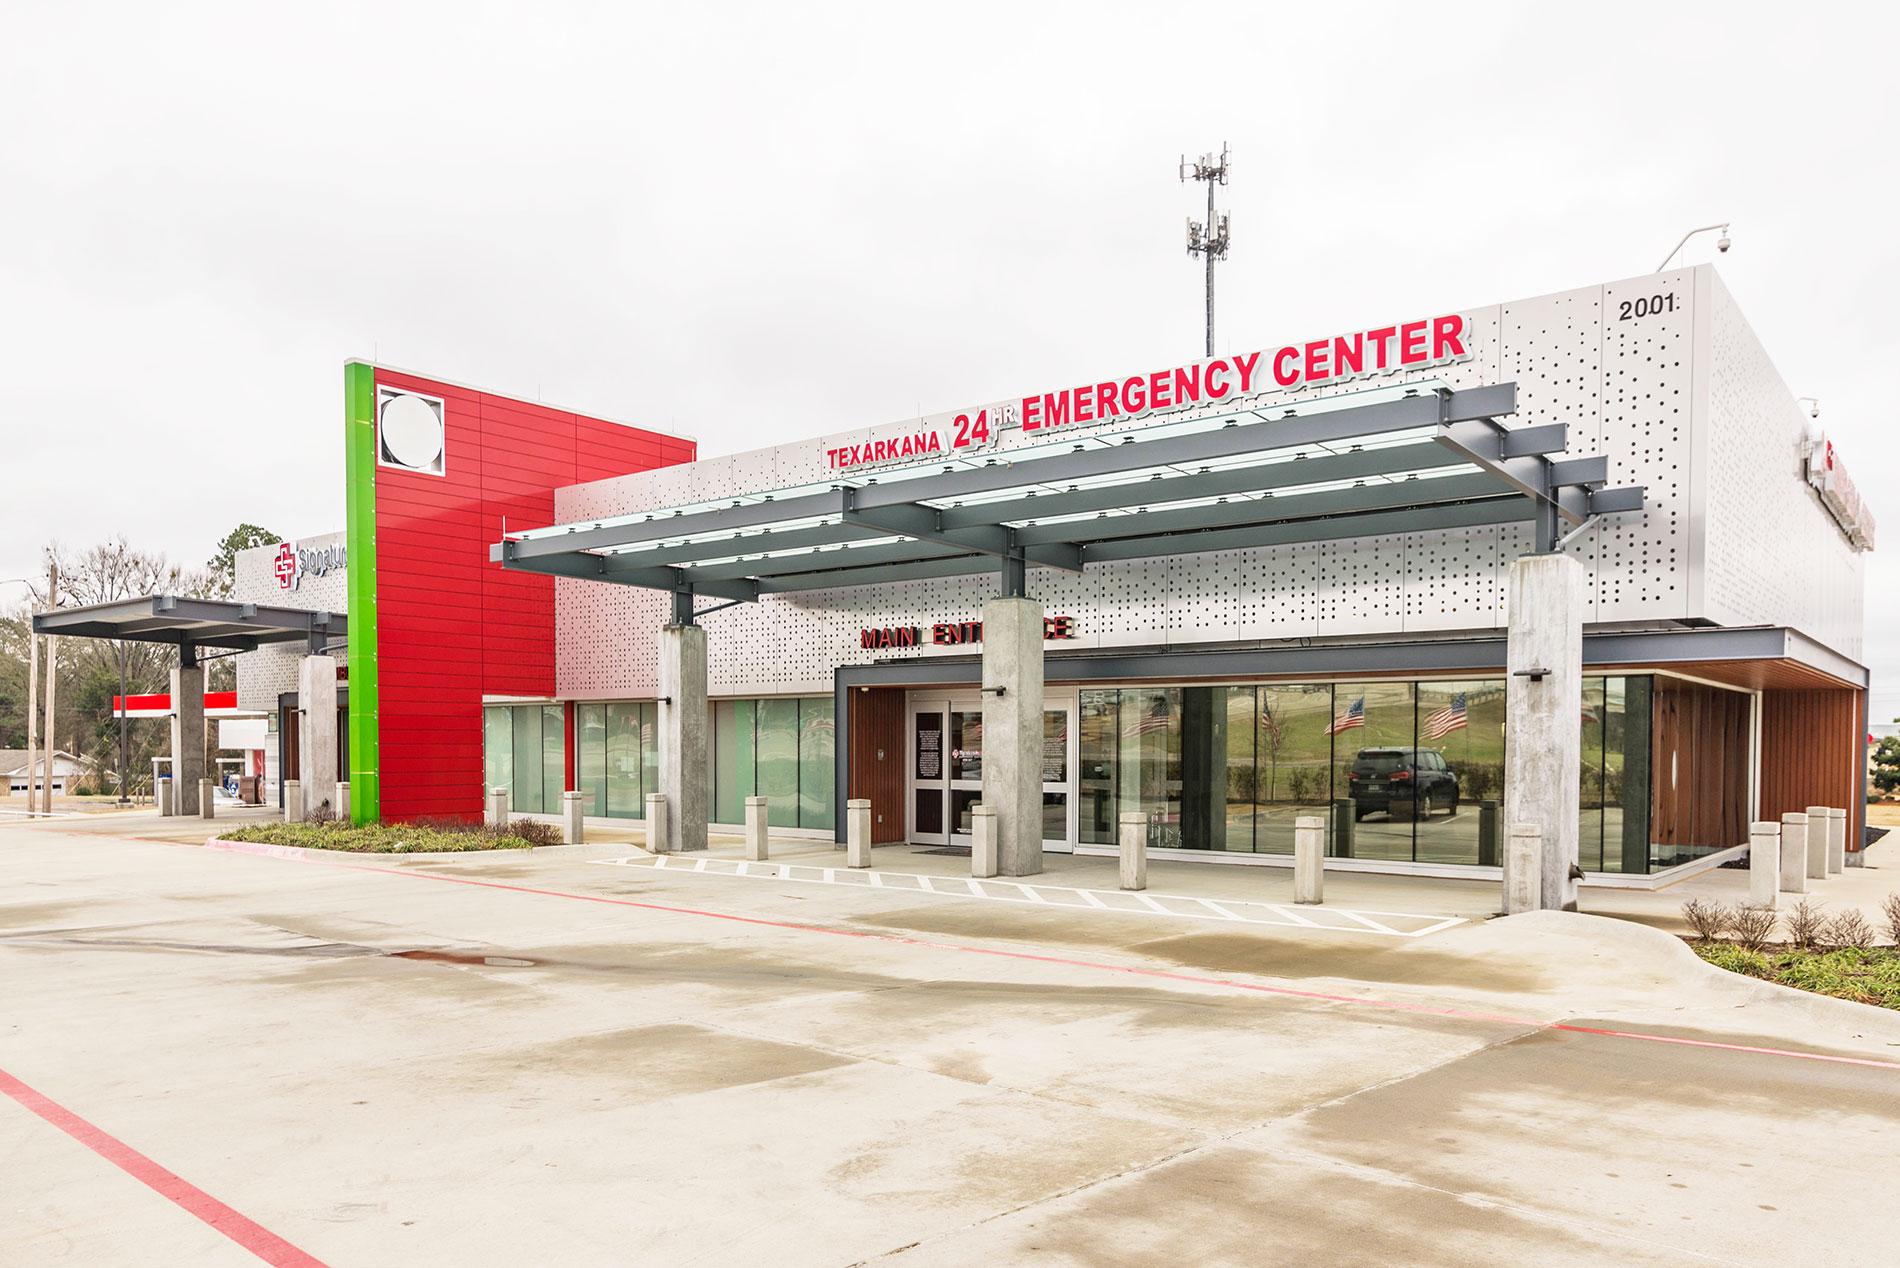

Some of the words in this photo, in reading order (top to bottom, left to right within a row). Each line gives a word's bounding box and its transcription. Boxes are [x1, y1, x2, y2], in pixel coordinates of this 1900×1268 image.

[1619, 292, 1674, 321] 2001
[827, 431, 941, 469] TEXARKANA
[953, 409, 990, 448] 24
[991, 405, 1015, 426] HR
[1022, 352, 1261, 431] EMERGENCY
[1273, 314, 1465, 386] CENTER
[861, 626, 916, 649] MAIN
[933, 616, 1073, 645] ENTE
